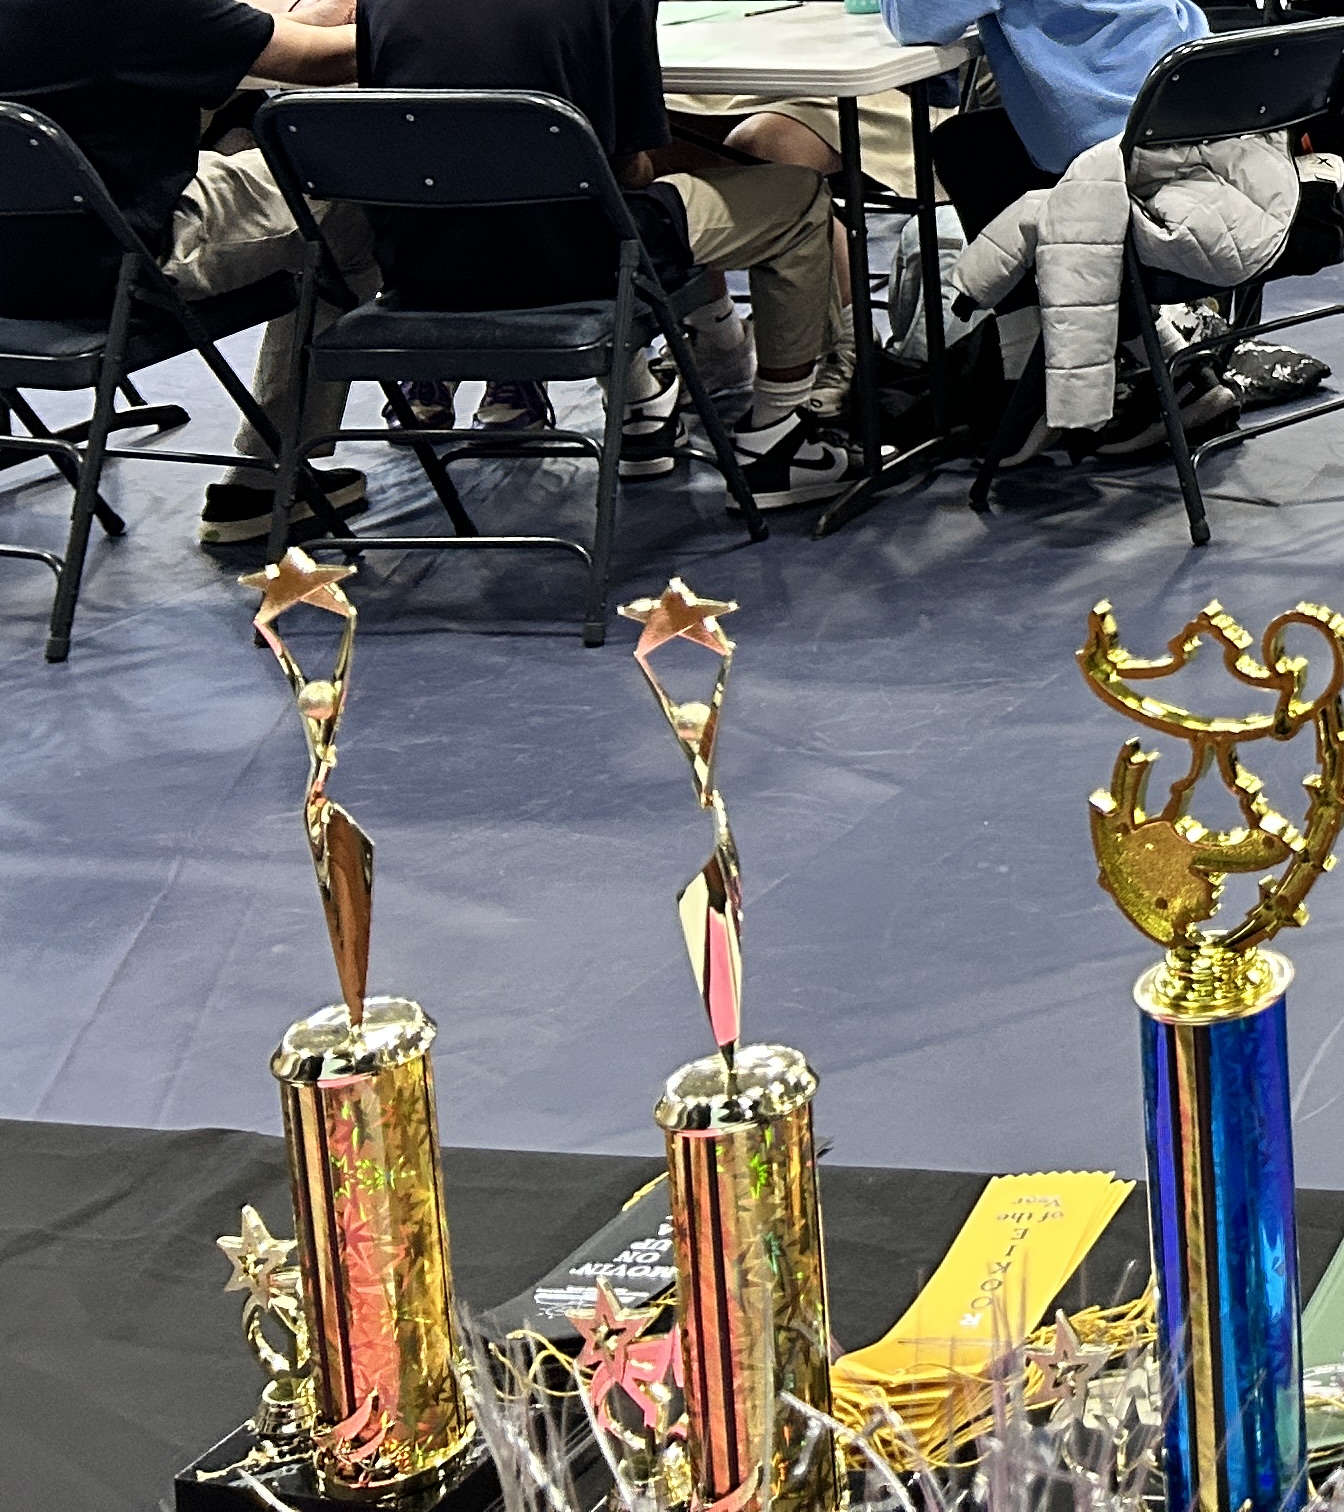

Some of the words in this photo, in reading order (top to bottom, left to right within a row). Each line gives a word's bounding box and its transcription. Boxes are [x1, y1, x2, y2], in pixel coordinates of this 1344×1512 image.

[1012, 1195, 1062, 1208] Year
[997, 1212, 1033, 1223] the
[1037, 1211, 1064, 1223] of
[630, 1239, 673, 1251] UP
[613, 1250, 661, 1264] ON
